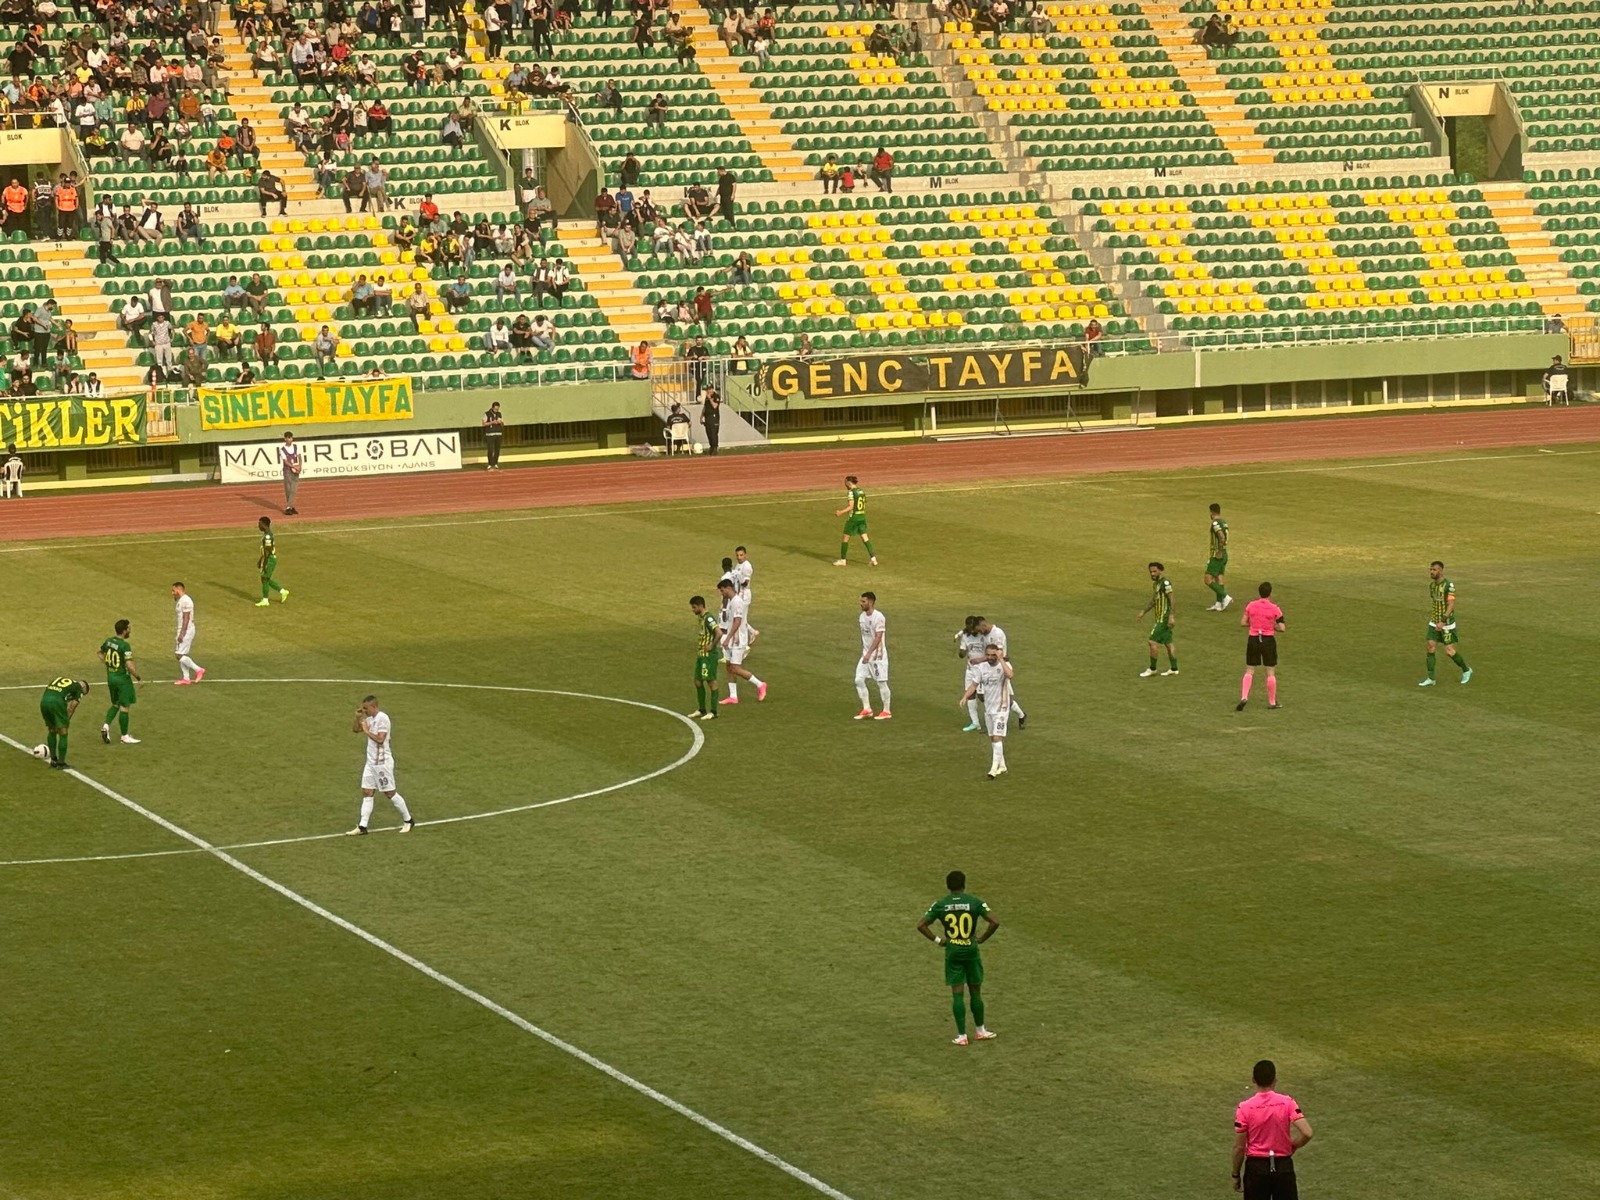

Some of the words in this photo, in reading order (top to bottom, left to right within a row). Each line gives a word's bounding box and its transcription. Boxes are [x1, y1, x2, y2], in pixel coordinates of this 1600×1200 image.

[1439, 87, 1450, 99] N
[500, 119, 511, 131] K
[1154, 167, 1166, 177] M
[1343, 161, 1354, 172] N
[930, 177, 942, 189] M
[394, 197, 406, 210] K
[772, 359, 903, 396] GENÇ
[930, 350, 1077, 388] TAYFA
[746, 384, 761, 396] 10
[203, 383, 314, 424] SİNEKLİ
[325, 384, 412, 416] TAYFA
[403, 460, 436, 470] AJANS
[105, 648, 120, 668] 40
[51, 677, 73, 688] 19
[944, 912, 973, 939] 30
